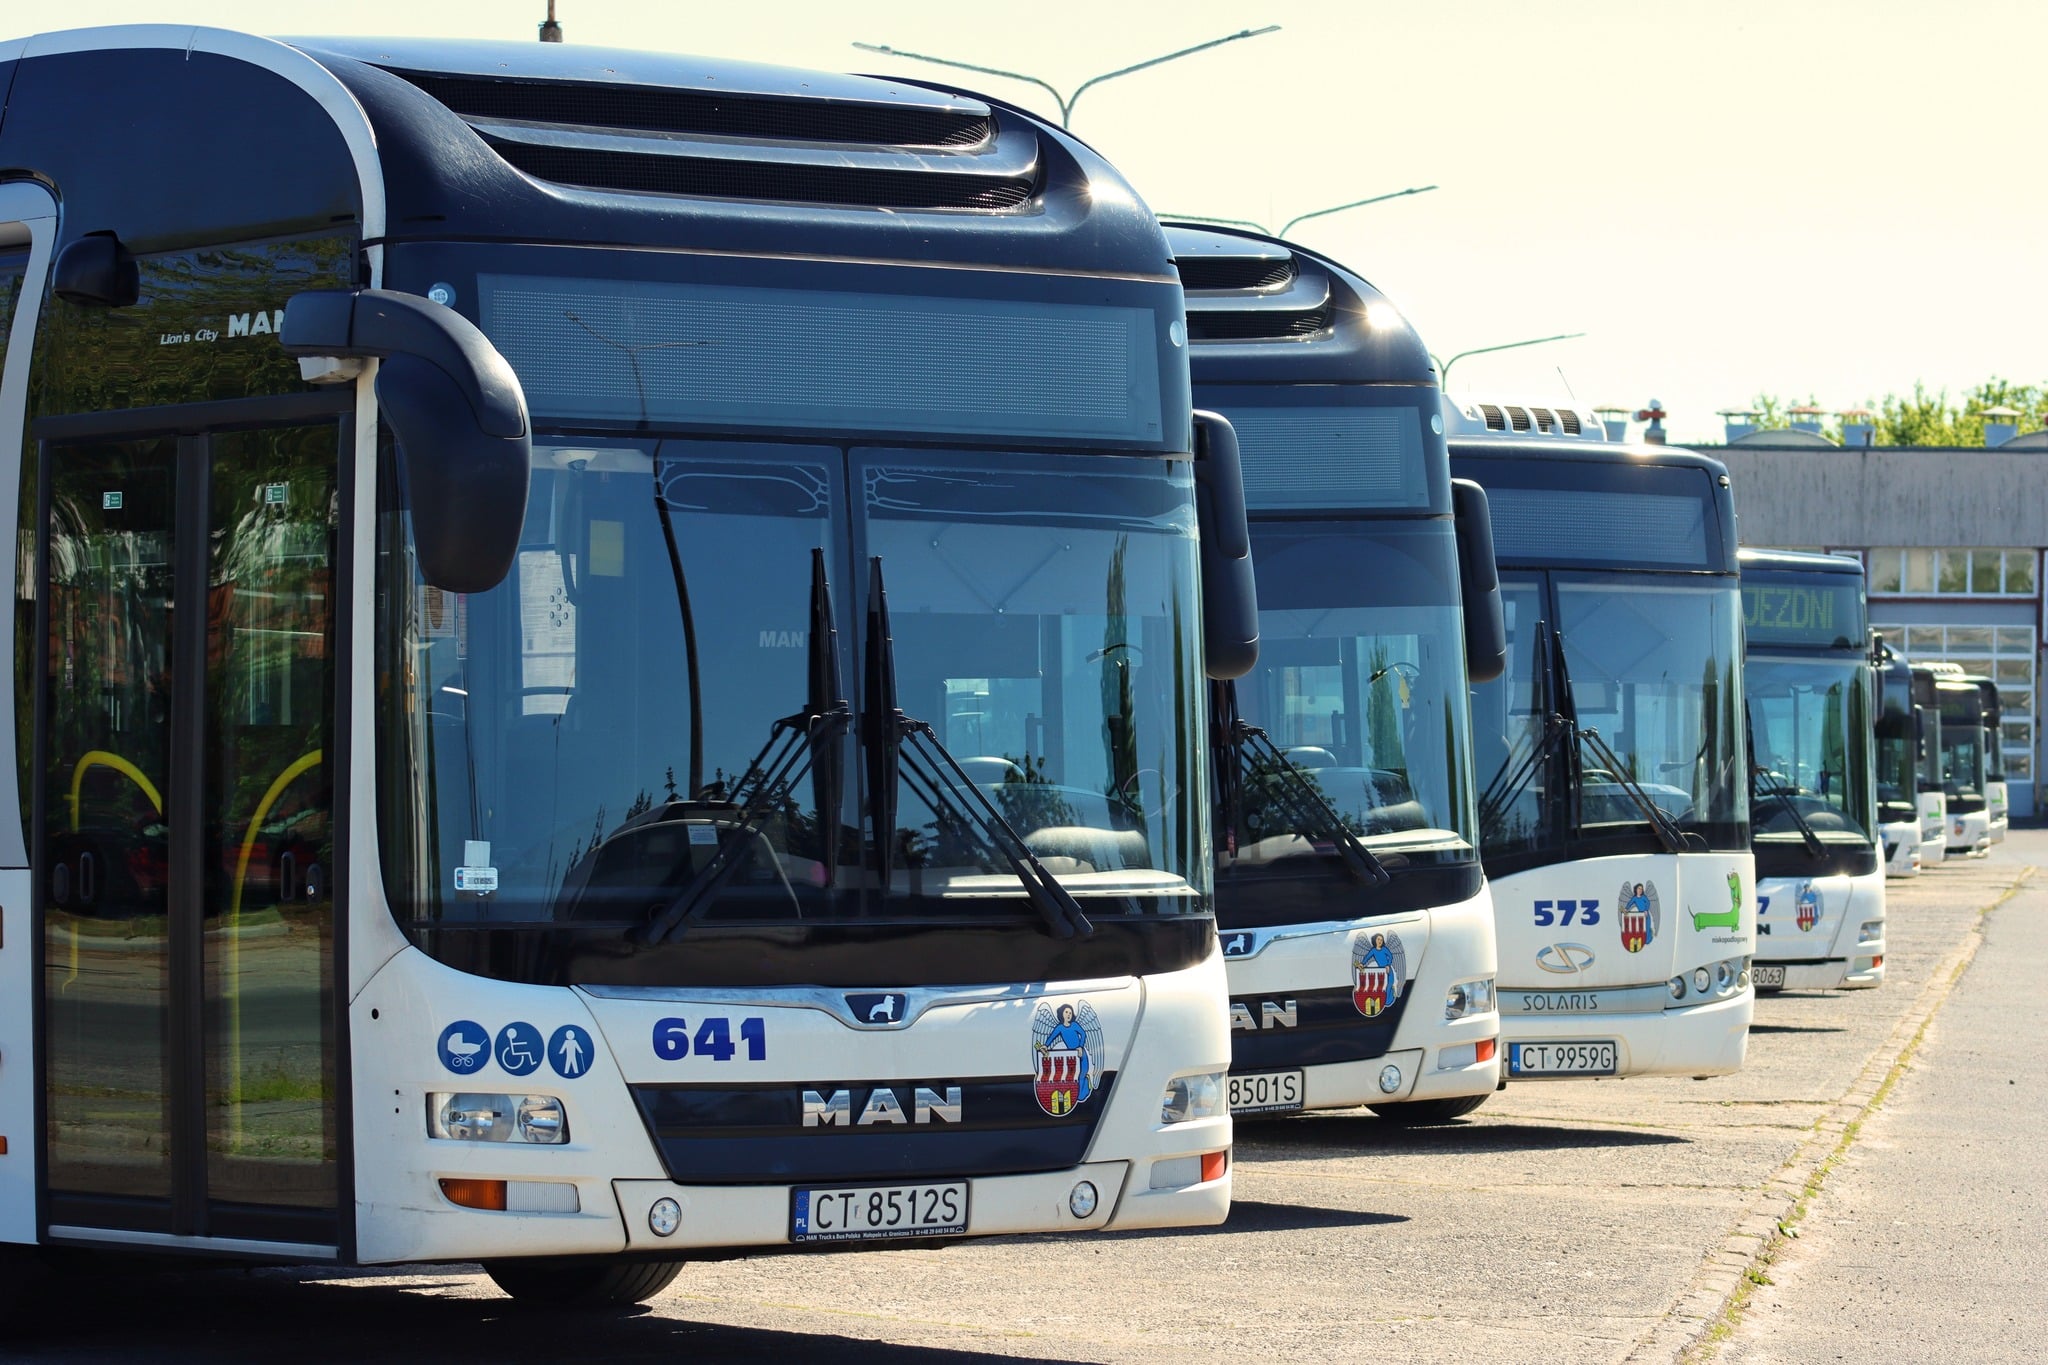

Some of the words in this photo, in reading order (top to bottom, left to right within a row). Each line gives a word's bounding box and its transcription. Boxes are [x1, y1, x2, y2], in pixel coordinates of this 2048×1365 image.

[160, 331, 190, 345] Lion's
[195, 329, 218, 343] City
[1743, 587, 1833, 629] JEZDNI
[759, 630, 804, 648] MAN
[1534, 900, 1600, 926] 573
[1757, 896, 1770, 915] 7
[1757, 924, 1771, 935] N
[1752, 968, 1782, 984] 8063
[1523, 994, 1598, 1011] SOLARIS
[1230, 1000, 1297, 1030] AN
[652, 1017, 766, 1061] 641
[1523, 1047, 1548, 1069] CT
[1556, 1047, 1611, 1069] 9959G
[1229, 1075, 1296, 1105] 8501S
[802, 1086, 962, 1127] MAN
[816, 1193, 856, 1229] CT
[867, 1187, 959, 1227] 8512S
[796, 1218, 806, 1228] PL
